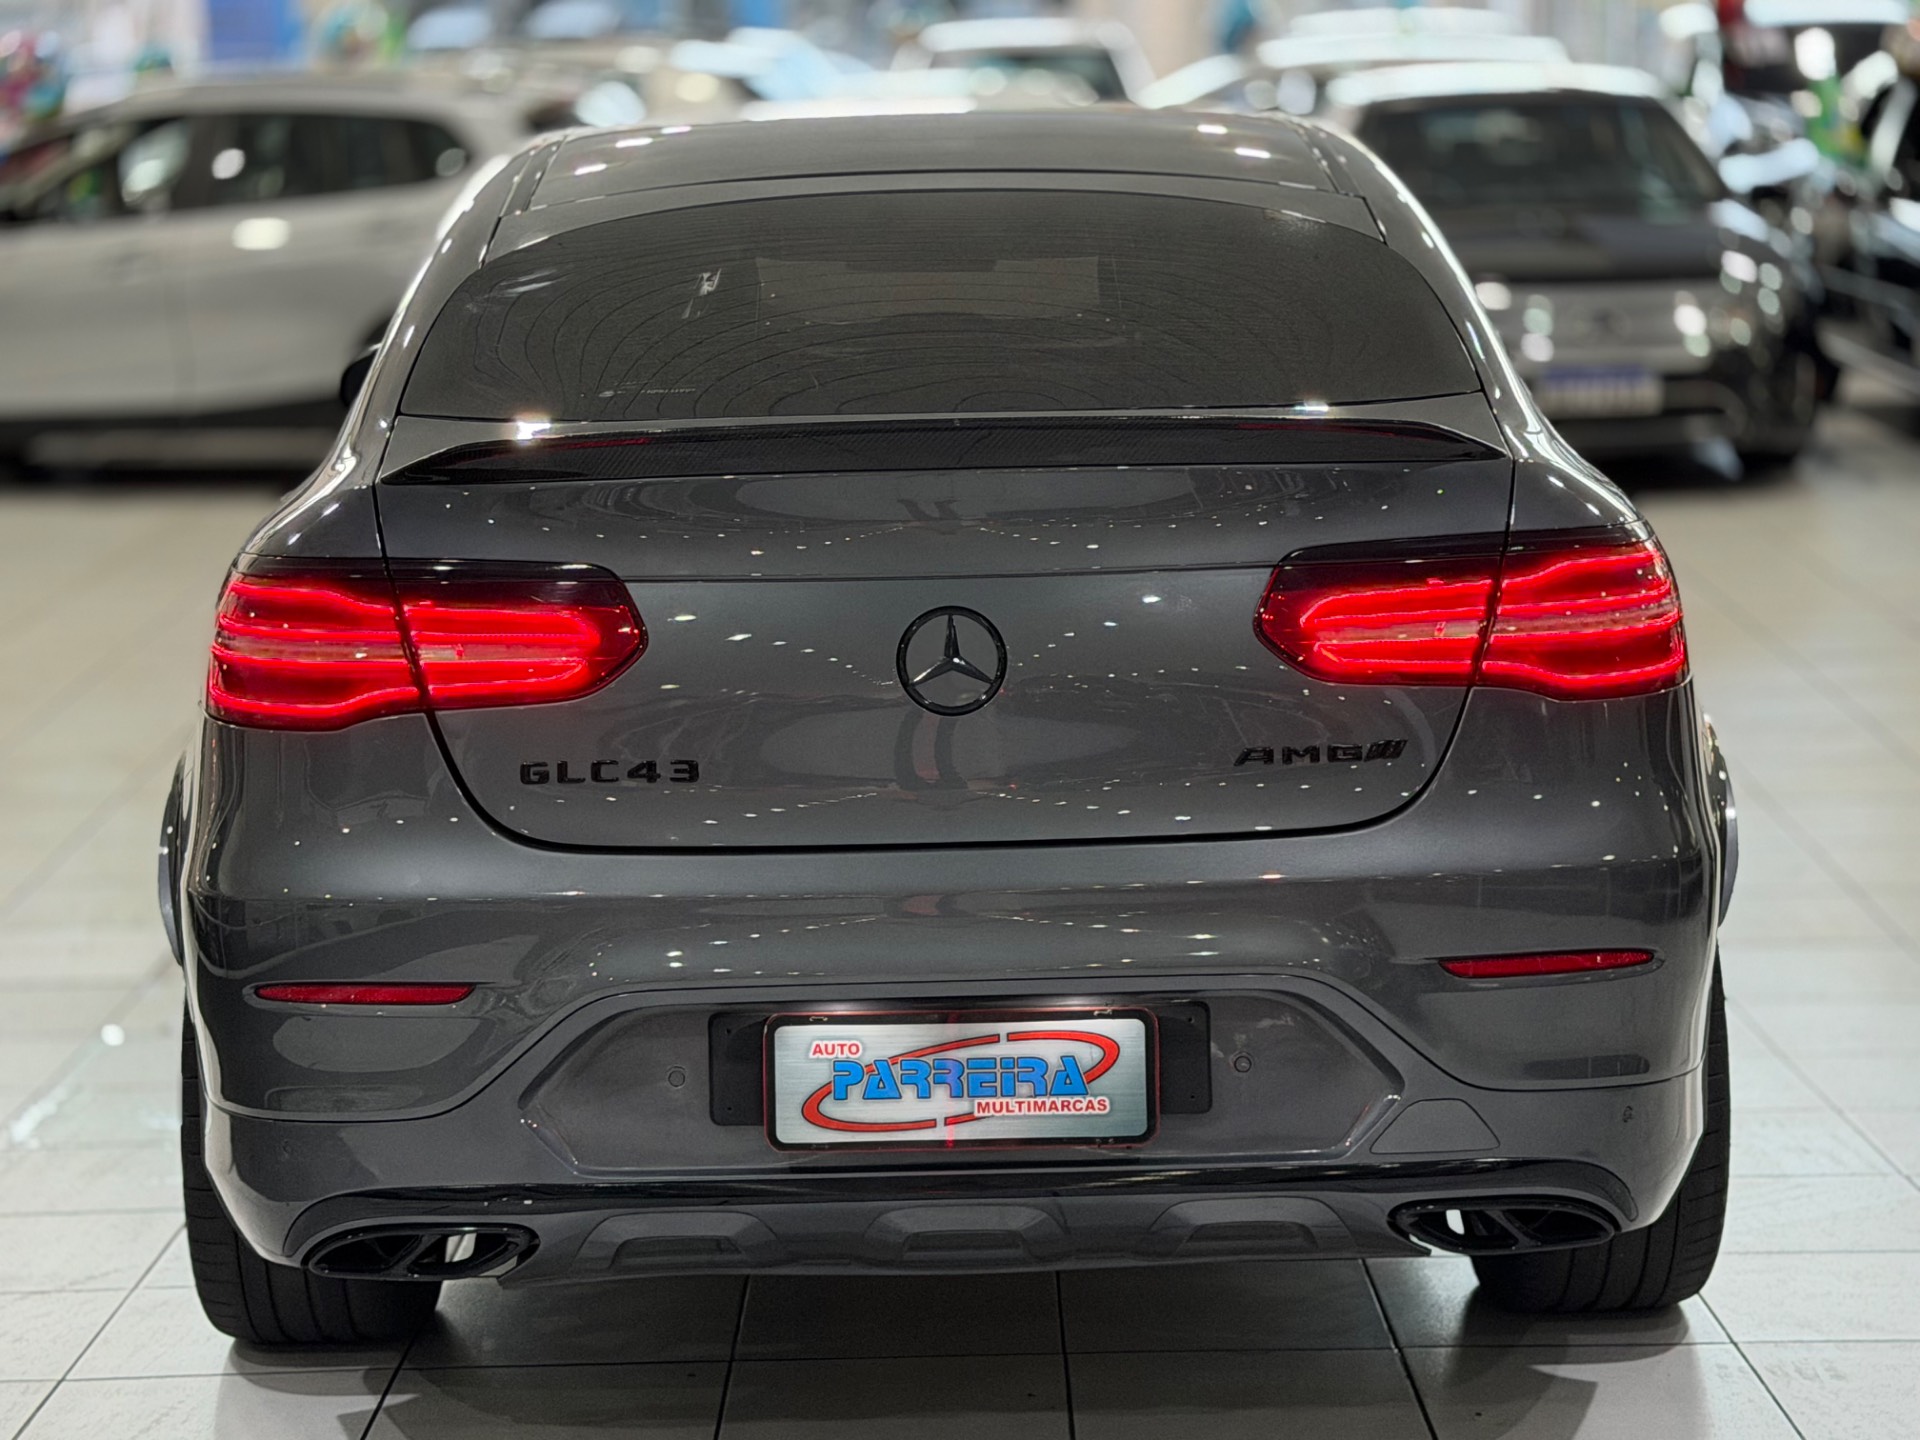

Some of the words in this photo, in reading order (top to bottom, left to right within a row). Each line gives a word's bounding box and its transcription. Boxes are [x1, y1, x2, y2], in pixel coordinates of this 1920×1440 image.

[1233, 744, 1363, 767] AMG
[519, 759, 700, 785] GLC43
[811, 1042, 861, 1056] AUTO
[976, 1098, 1109, 1114] MULTIMARCAS
